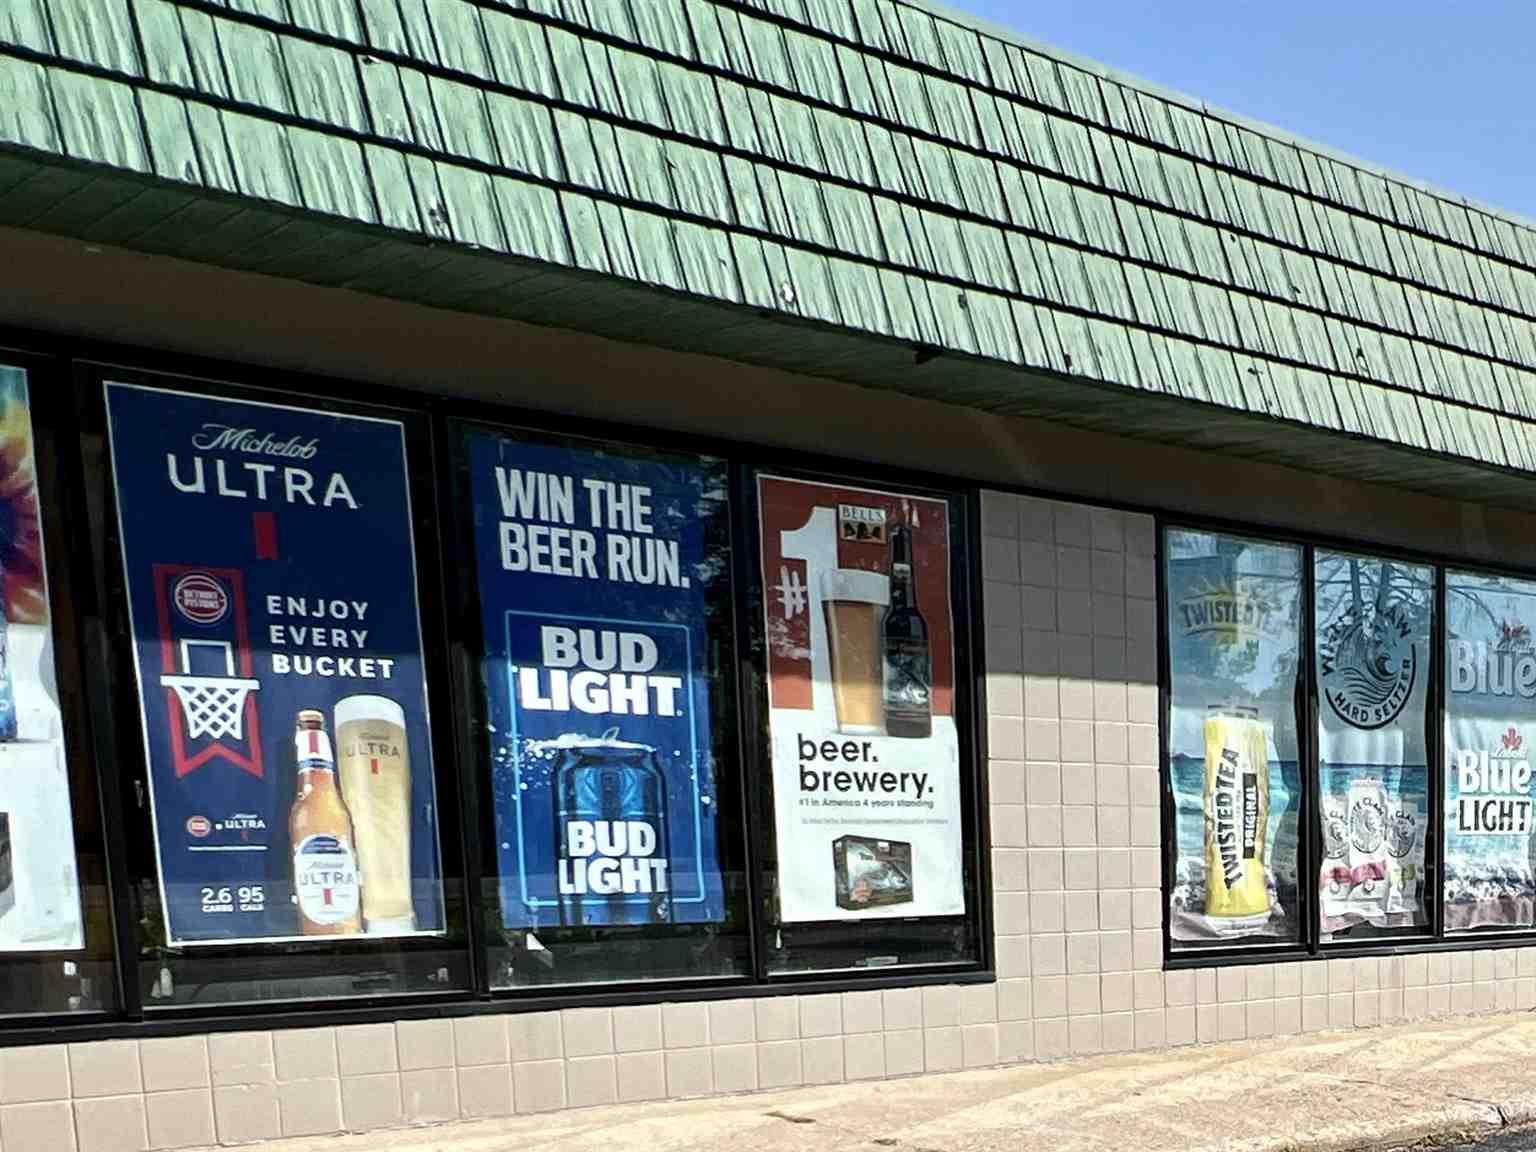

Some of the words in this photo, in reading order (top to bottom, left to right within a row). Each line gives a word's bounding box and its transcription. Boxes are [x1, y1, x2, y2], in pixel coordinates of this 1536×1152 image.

[192, 424, 320, 459] Michelob
[167, 453, 358, 509] ULTRA
[495, 466, 575, 524] WIN
[582, 479, 654, 534] THE
[499, 521, 600, 579] BEER
[606, 533, 691, 589] RUN.
[266, 595, 368, 620] ENJOY
[269, 625, 368, 648] EVERY
[541, 625, 658, 673] BUD
[271, 653, 394, 679] BUCKET
[520, 666, 682, 717] LIGHT
[1334, 692, 1369, 721] HARD
[1374, 659, 1412, 721] SELTZER
[798, 732, 879, 762] beer.
[799, 764, 935, 799] brewery.
[1215, 748, 1240, 790] TEA
[1458, 748, 1532, 795] Blue
[821, 798, 861, 808] America
[862, 798, 869, 807] 4
[871, 799, 895, 808] years
[896, 799, 935, 810] standing
[1458, 799, 1531, 832] LIGHT
[224, 819, 266, 829] ULTRA
[567, 820, 656, 857] BUD
[1215, 792, 1243, 891] TWISTED
[299, 871, 354, 886] ULTRA
[558, 857, 668, 895] LIGHT
[237, 886, 264, 903] 95
